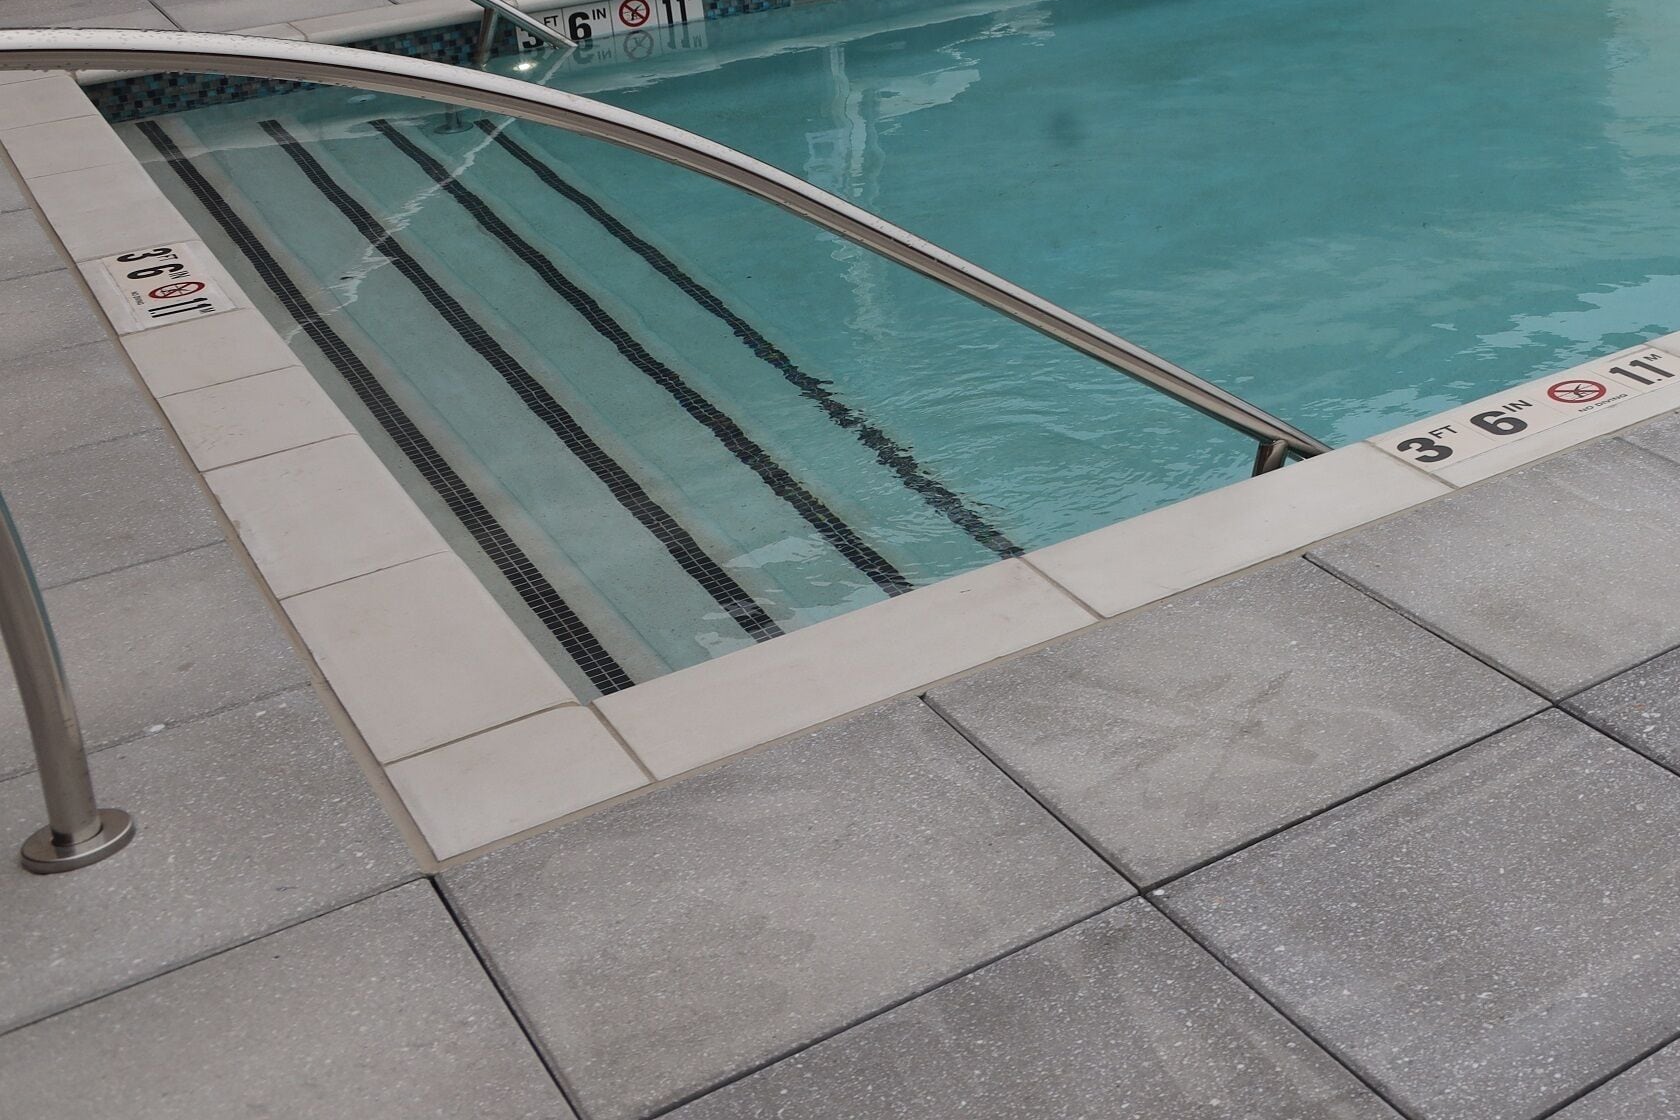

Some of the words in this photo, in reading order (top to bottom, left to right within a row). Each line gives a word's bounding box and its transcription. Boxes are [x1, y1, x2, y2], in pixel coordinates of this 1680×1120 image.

[543, 15, 558, 26] FT
[568, 11, 592, 41] 6
[592, 8, 606, 21] IN
[117, 248, 172, 262] 3
[127, 264, 184, 279] 6
[1594, 393, 1628, 407] DIVING
[1397, 437, 1453, 463] 3
[1428, 425, 1457, 439] FT
[1470, 411, 1528, 436] 6
[1502, 399, 1533, 412] IN
[1643, 353, 1662, 362] M
